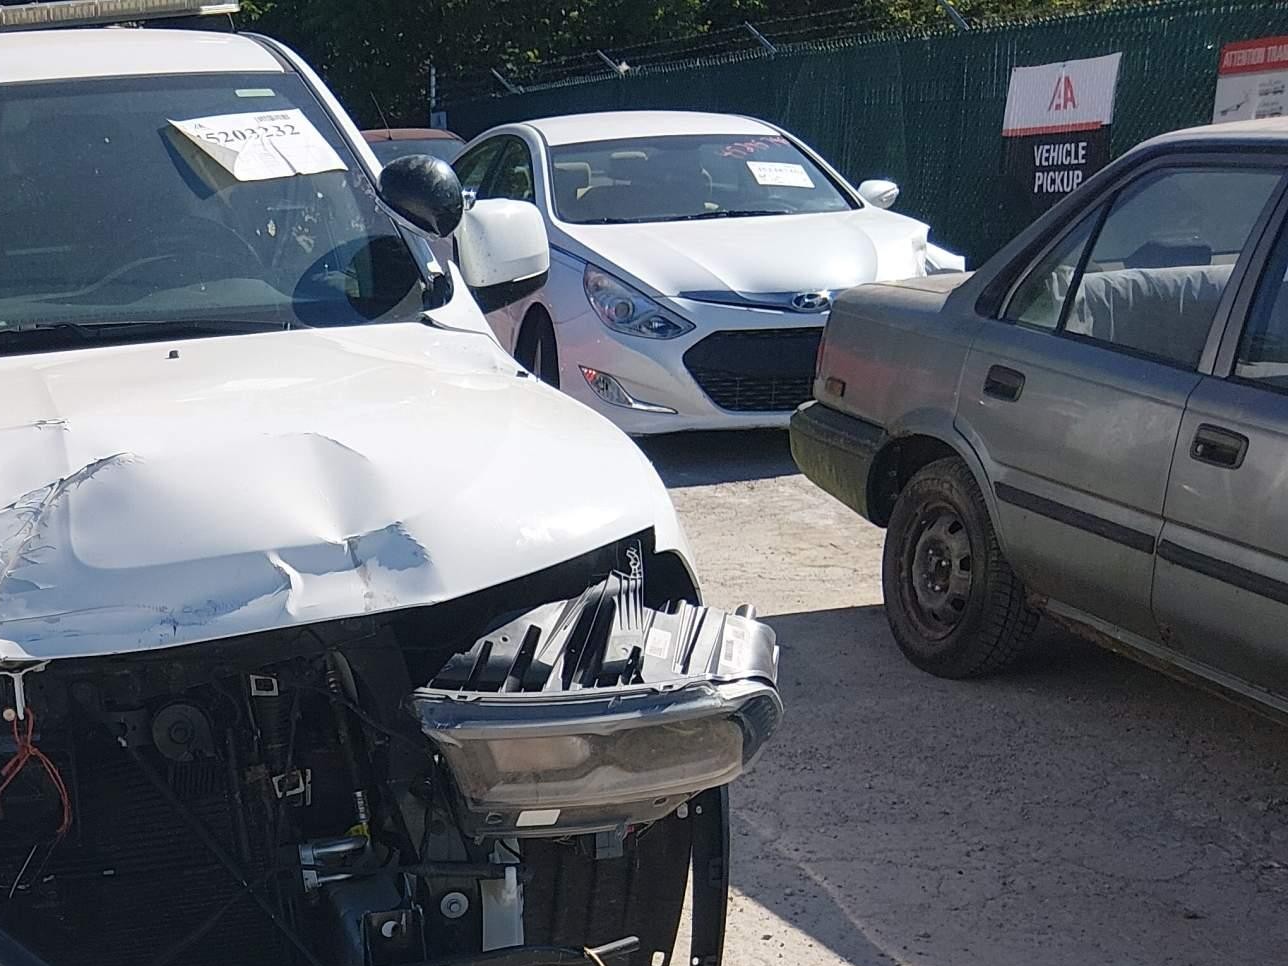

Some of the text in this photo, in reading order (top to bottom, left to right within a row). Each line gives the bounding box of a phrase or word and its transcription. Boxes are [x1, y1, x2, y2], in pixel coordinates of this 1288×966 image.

[1222, 48, 1265, 67] ATTENTION
[1034, 142, 1087, 166] VEHICLE
[1034, 170, 1083, 193] PICKUP
